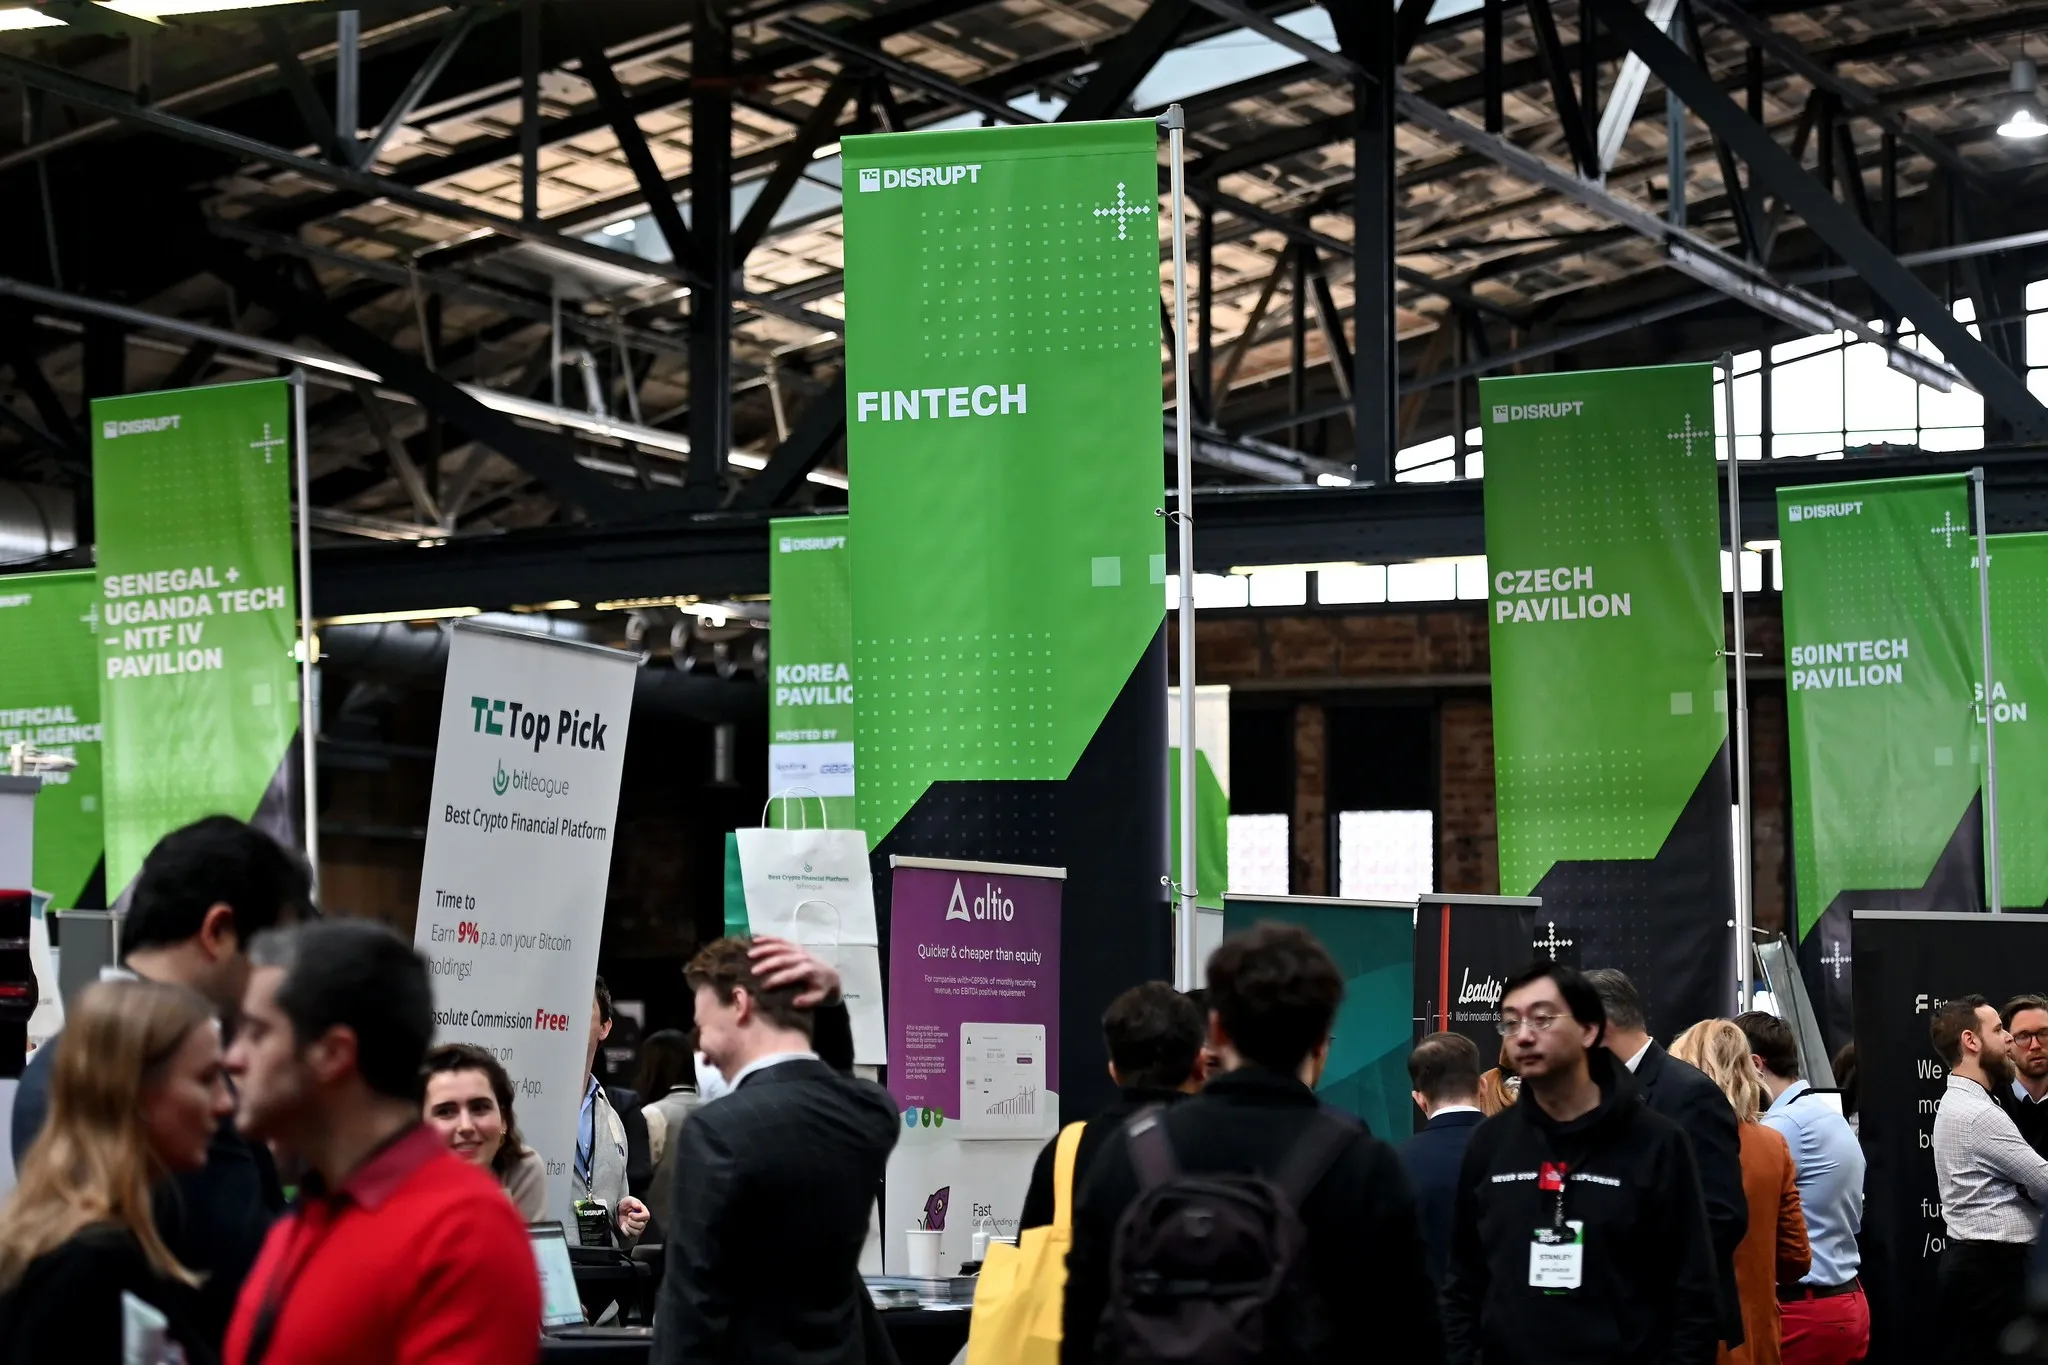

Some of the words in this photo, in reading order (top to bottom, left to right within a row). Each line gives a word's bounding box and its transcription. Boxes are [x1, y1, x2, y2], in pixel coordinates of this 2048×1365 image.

[884, 164, 982, 189] DISRUPT
[857, 383, 1027, 422] FINTECH
[1511, 401, 1584, 421] DISRUPT
[119, 414, 181, 436] DISRUPT
[1803, 501, 1863, 519] DISRUPT
[792, 536, 847, 551] DISRUPT
[104, 566, 221, 598] SENEGAL
[226, 567, 239, 583] +
[1494, 566, 1593, 595] CZECH
[104, 595, 213, 625] UGANDA
[217, 586, 285, 614] TECH
[1496, 593, 1631, 624] PAVILION
[124, 624, 173, 651] NTF
[178, 622, 203, 646] IV
[107, 647, 222, 680] PAVILION
[1791, 638, 1909, 666] 50INTECH
[776, 662, 849, 684] KOREA
[1792, 663, 1903, 691] PAVILION
[1974, 681, 2007, 702] SA
[471, 696, 506, 736] TC
[509, 702, 550, 753] Top
[557, 709, 608, 751] Pick
[1976, 703, 2027, 724] LON
[776, 729, 821, 741] HOSTED
[822, 729, 837, 740] BY
[512, 769, 569, 798] bitleague
[445, 805, 471, 826] Best
[473, 808, 508, 833] Crypto
[510, 813, 559, 836] Financial
[561, 819, 607, 841] Platform
[435, 890, 463, 909] Time
[465, 894, 476, 910] to
[974, 882, 1014, 922] altio
[431, 923, 456, 943] Earn
[457, 921, 479, 944] 9%
[481, 931, 498, 950] p.a.
[500, 932, 513, 947] on
[514, 934, 538, 953] your
[539, 932, 572, 952] Bitcoin
[917, 943, 950, 960] Quicker
[950, 945, 958, 959] &
[959, 945, 994, 962] cheaper
[996, 946, 1014, 961] than
[1015, 948, 1042, 966] equity
[428, 956, 473, 982] holdings!
[1458, 967, 1508, 1009] Leadsp
[471, 1010, 532, 1030] Commission
[535, 1008, 570, 1032] Free!
[1455, 1011, 1468, 1022] World
[500, 1047, 513, 1061] on
[1917, 1059, 1942, 1080] We
[521, 1077, 543, 1099] App.
[546, 1158, 566, 1176] than
[1517, 1172, 1538, 1181] STOP
[583, 1209, 606, 1217] DISRUPT
[972, 1202, 992, 1217] Fast
[993, 1218, 1013, 1228] unding
